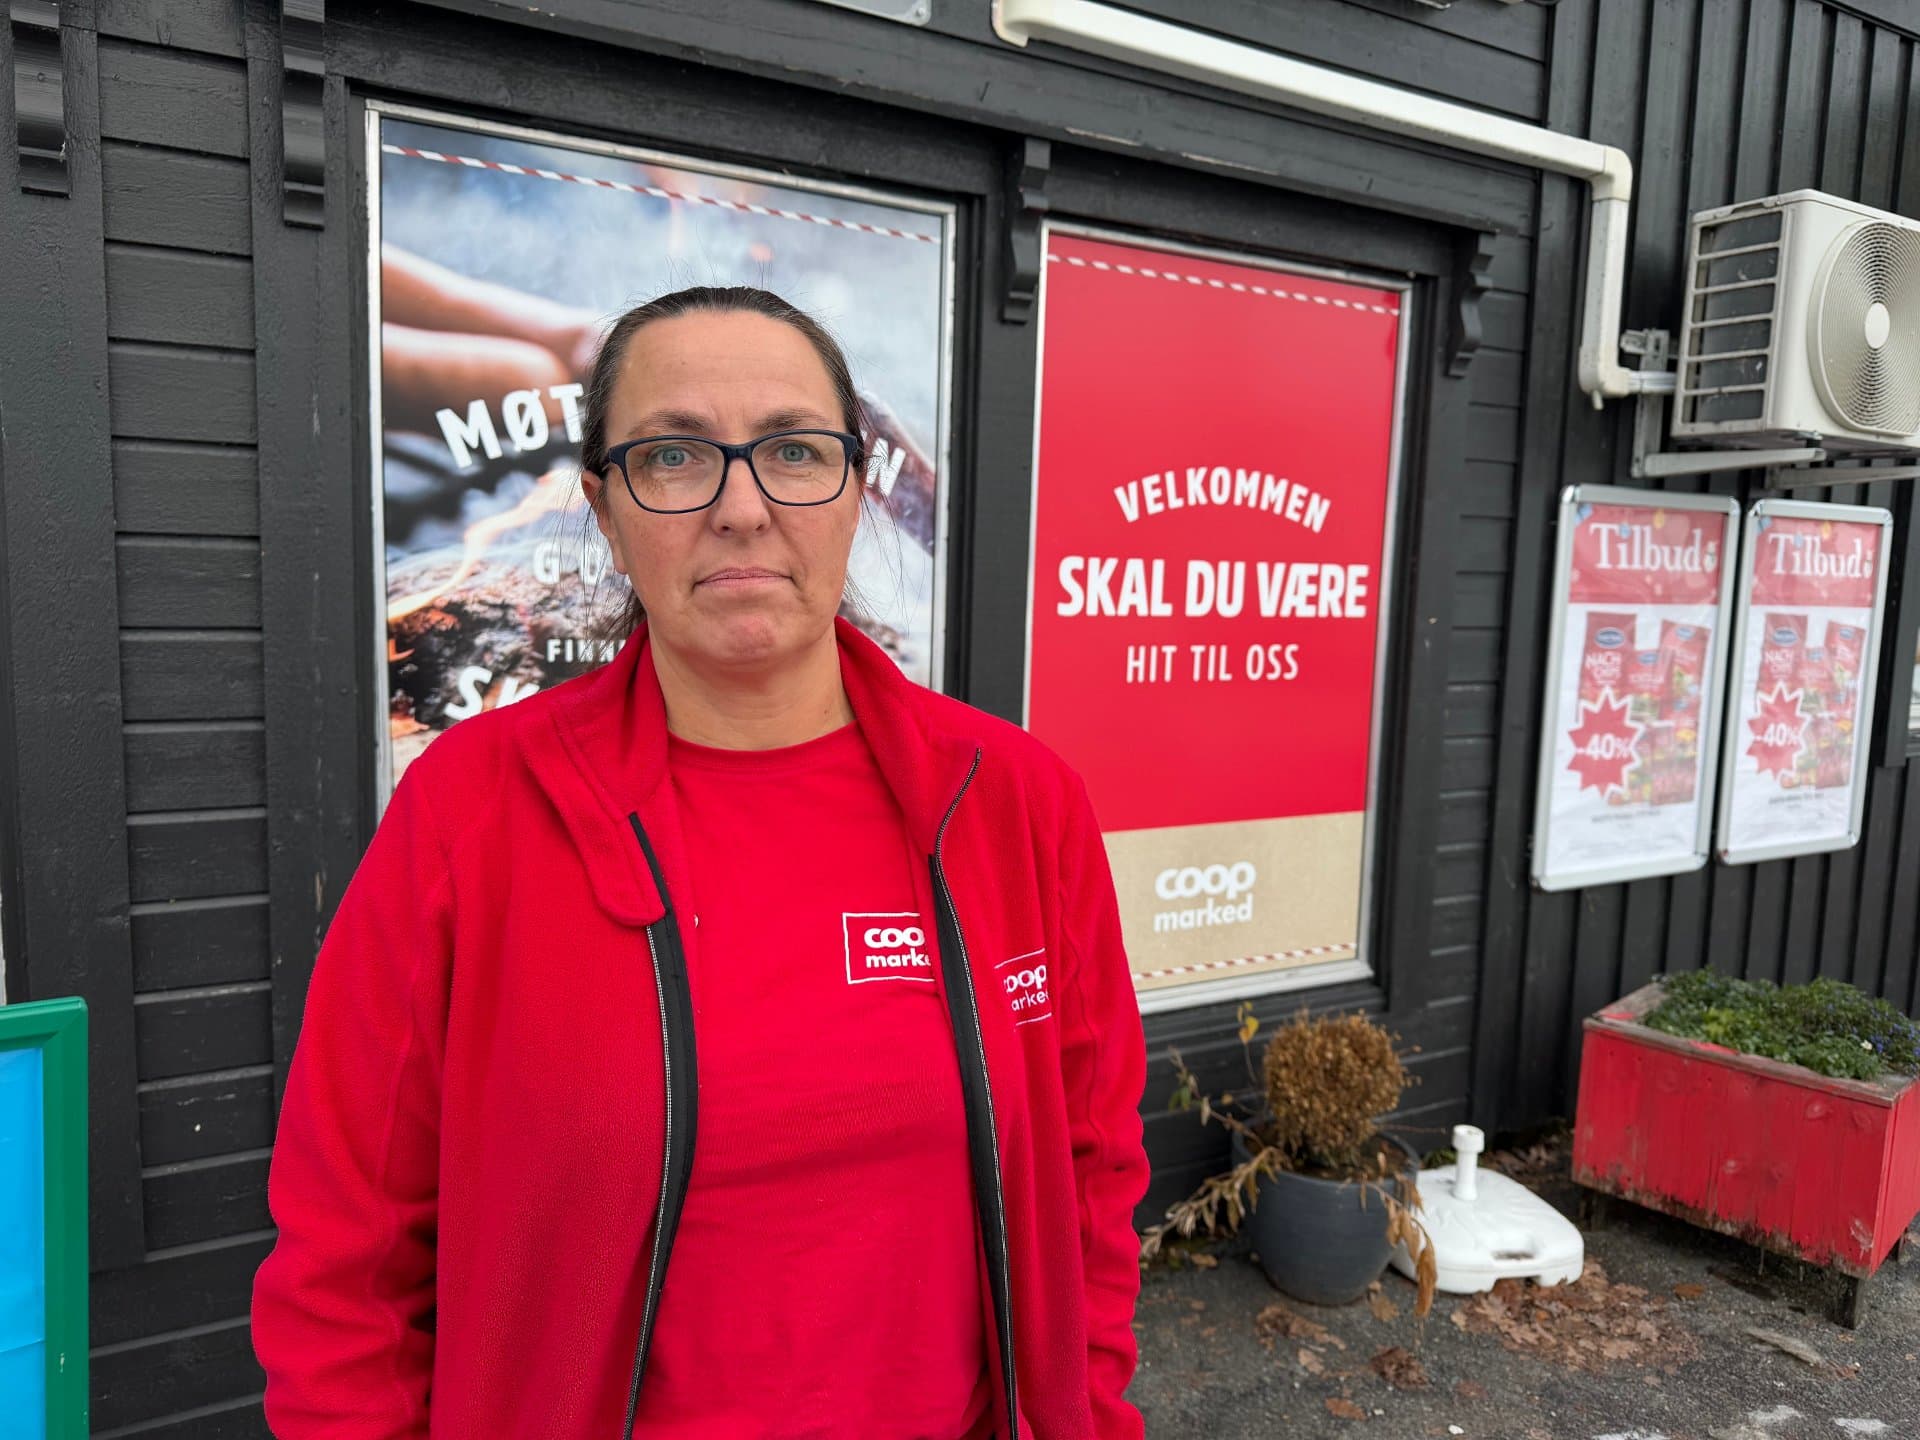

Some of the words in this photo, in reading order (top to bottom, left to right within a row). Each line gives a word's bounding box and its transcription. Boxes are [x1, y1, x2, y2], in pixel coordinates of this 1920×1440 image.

[1114, 466, 1331, 534] VELKOMMEN
[1056, 555, 1173, 617] SKAL
[1185, 559, 1246, 618] DU
[1256, 561, 1369, 618] VÆRE
[547, 637, 627, 664] FINN
[1126, 644, 1177, 683] HIT
[1190, 644, 1232, 682] TIL
[1246, 643, 1299, 681] OSS
[1574, 732, 1631, 761] -40%
[1754, 722, 1801, 748] -40%
[1154, 861, 1256, 900] coop
[1153, 893, 1253, 932] marked
[864, 926, 925, 949] coo
[1003, 964, 1047, 994] oop
[1011, 989, 1050, 1012] arke
